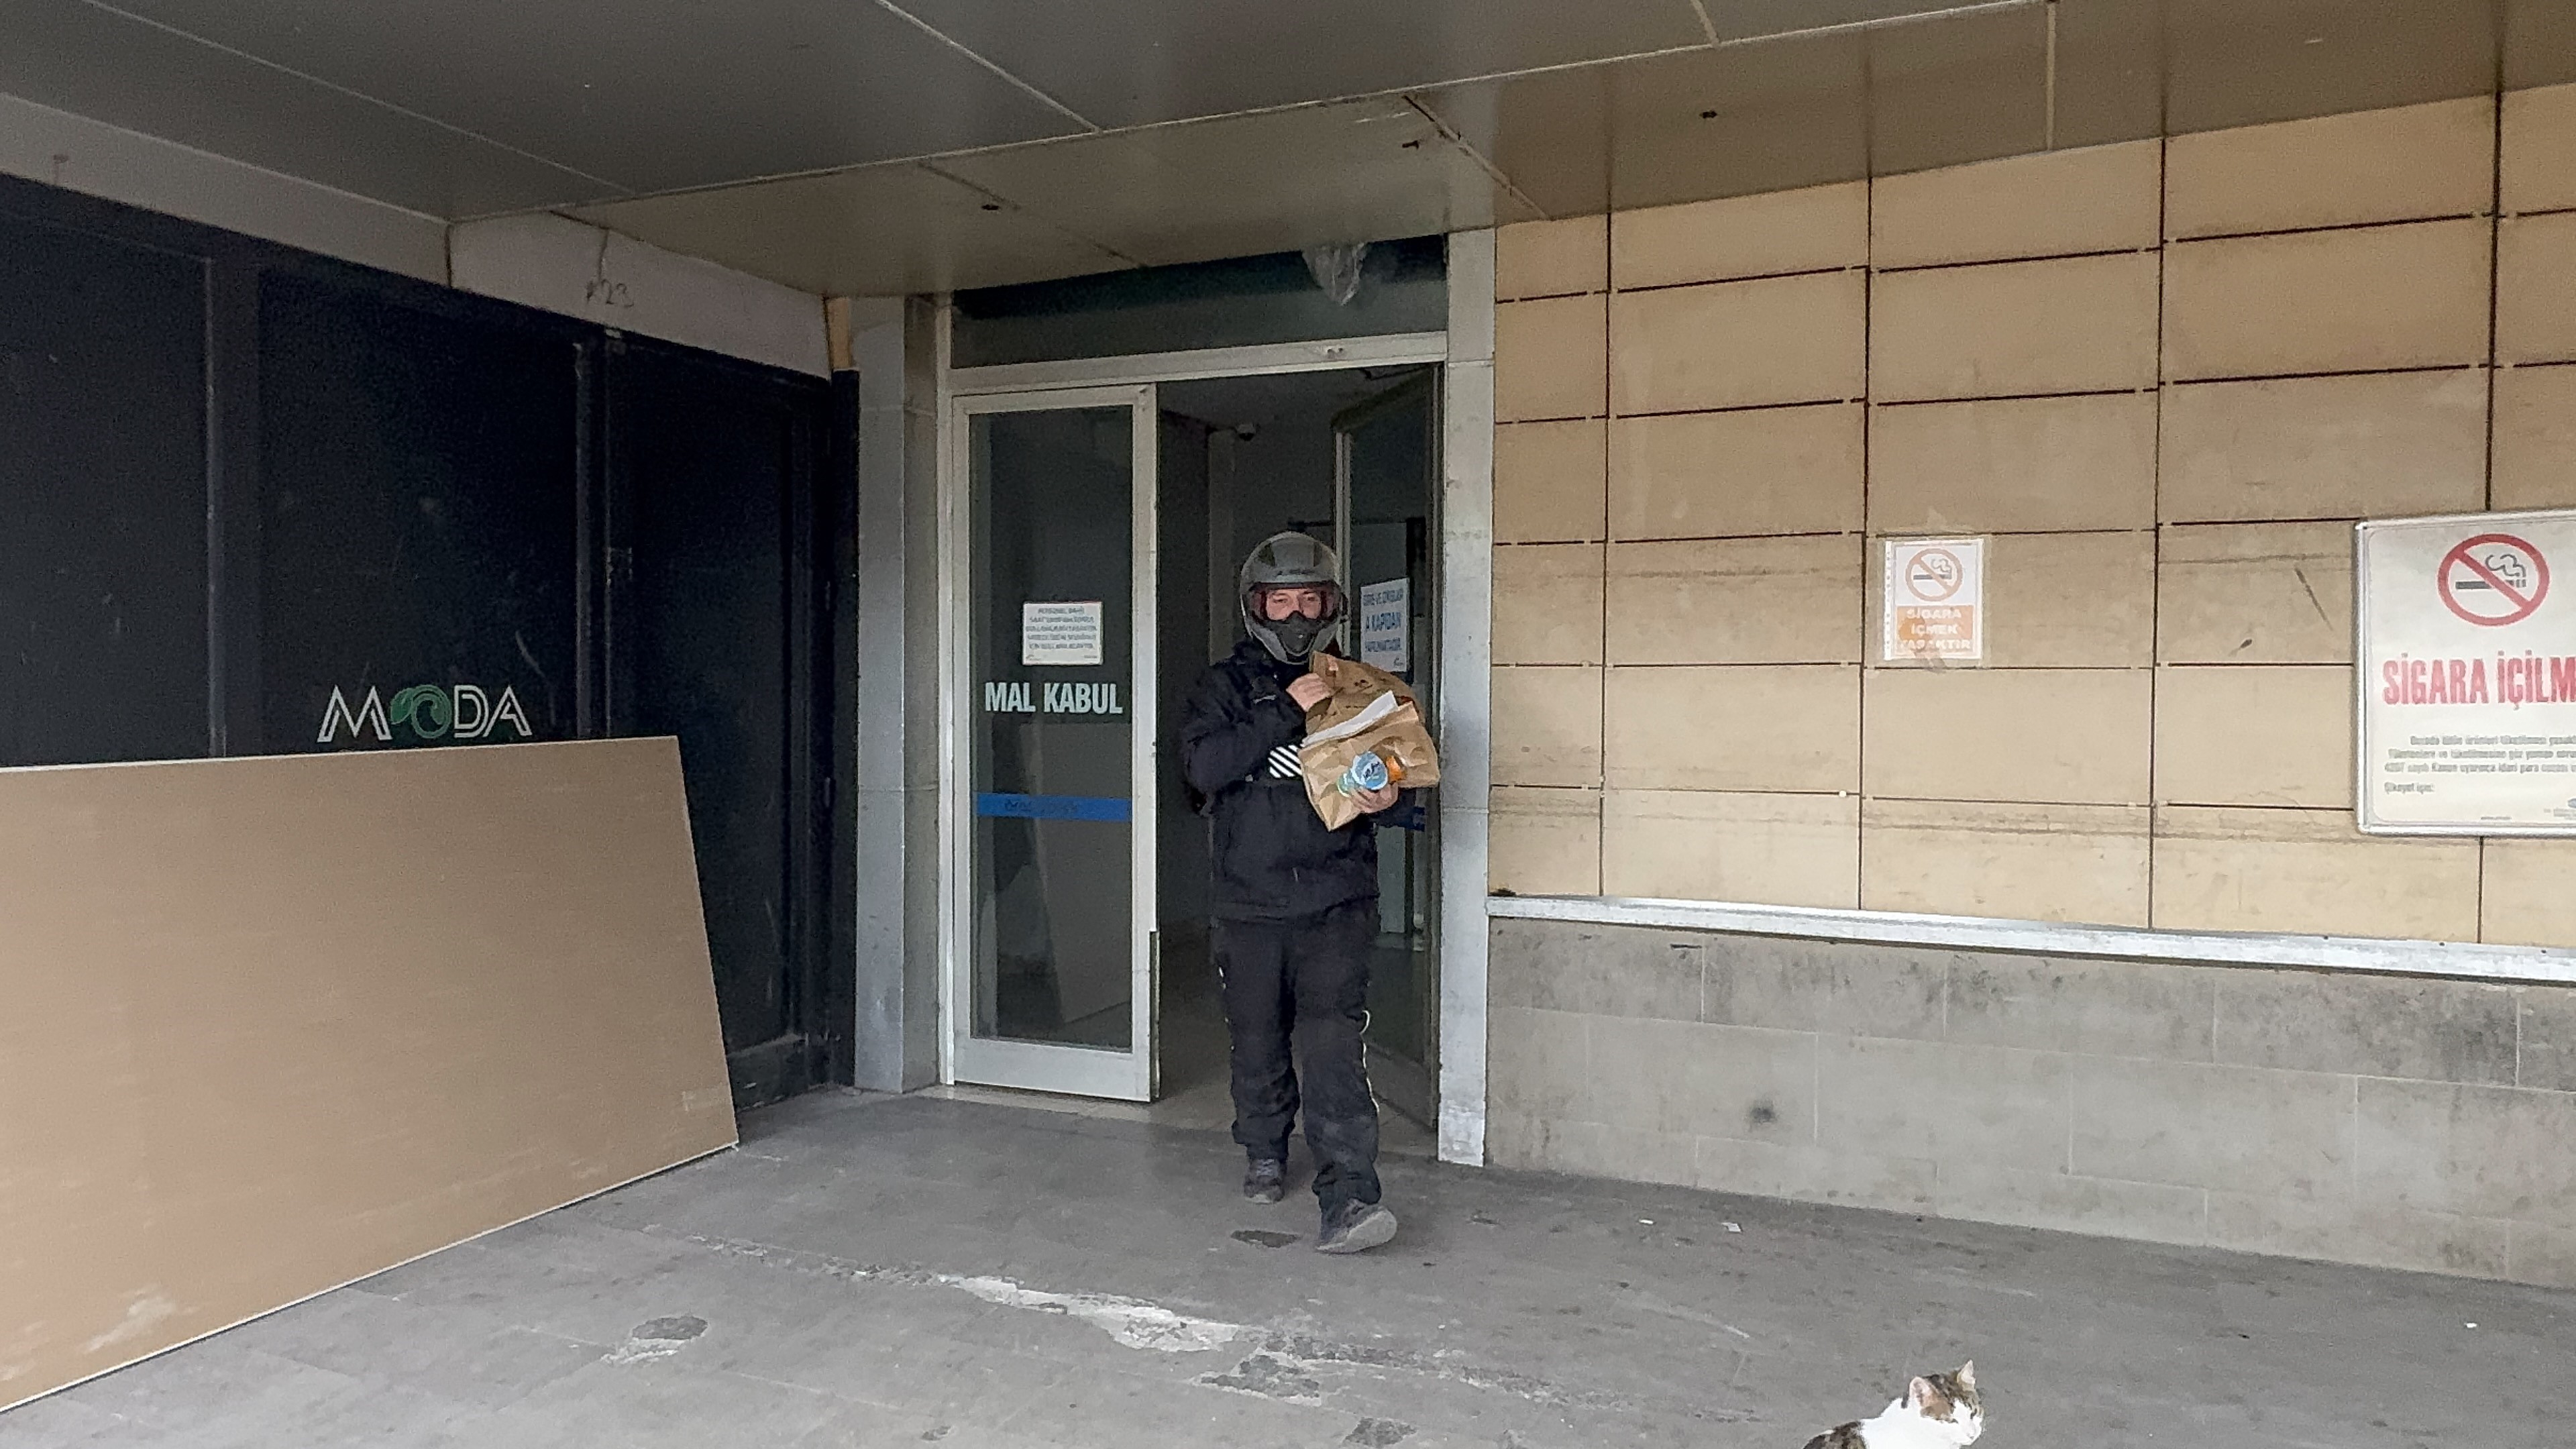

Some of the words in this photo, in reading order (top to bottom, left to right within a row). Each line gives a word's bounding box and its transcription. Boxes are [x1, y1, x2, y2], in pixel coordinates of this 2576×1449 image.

[1906, 607, 1962, 619] SİGARA
[1911, 623, 1960, 637] İÇMEK
[1899, 639, 1971, 650] YASKTIR
[2383, 652, 2489, 706] SİGARA
[2498, 649, 2576, 711] İÇİLM
[985, 682, 1036, 712] MAL
[1044, 682, 1123, 714] KABUL
[317, 684, 533, 743] MODA
